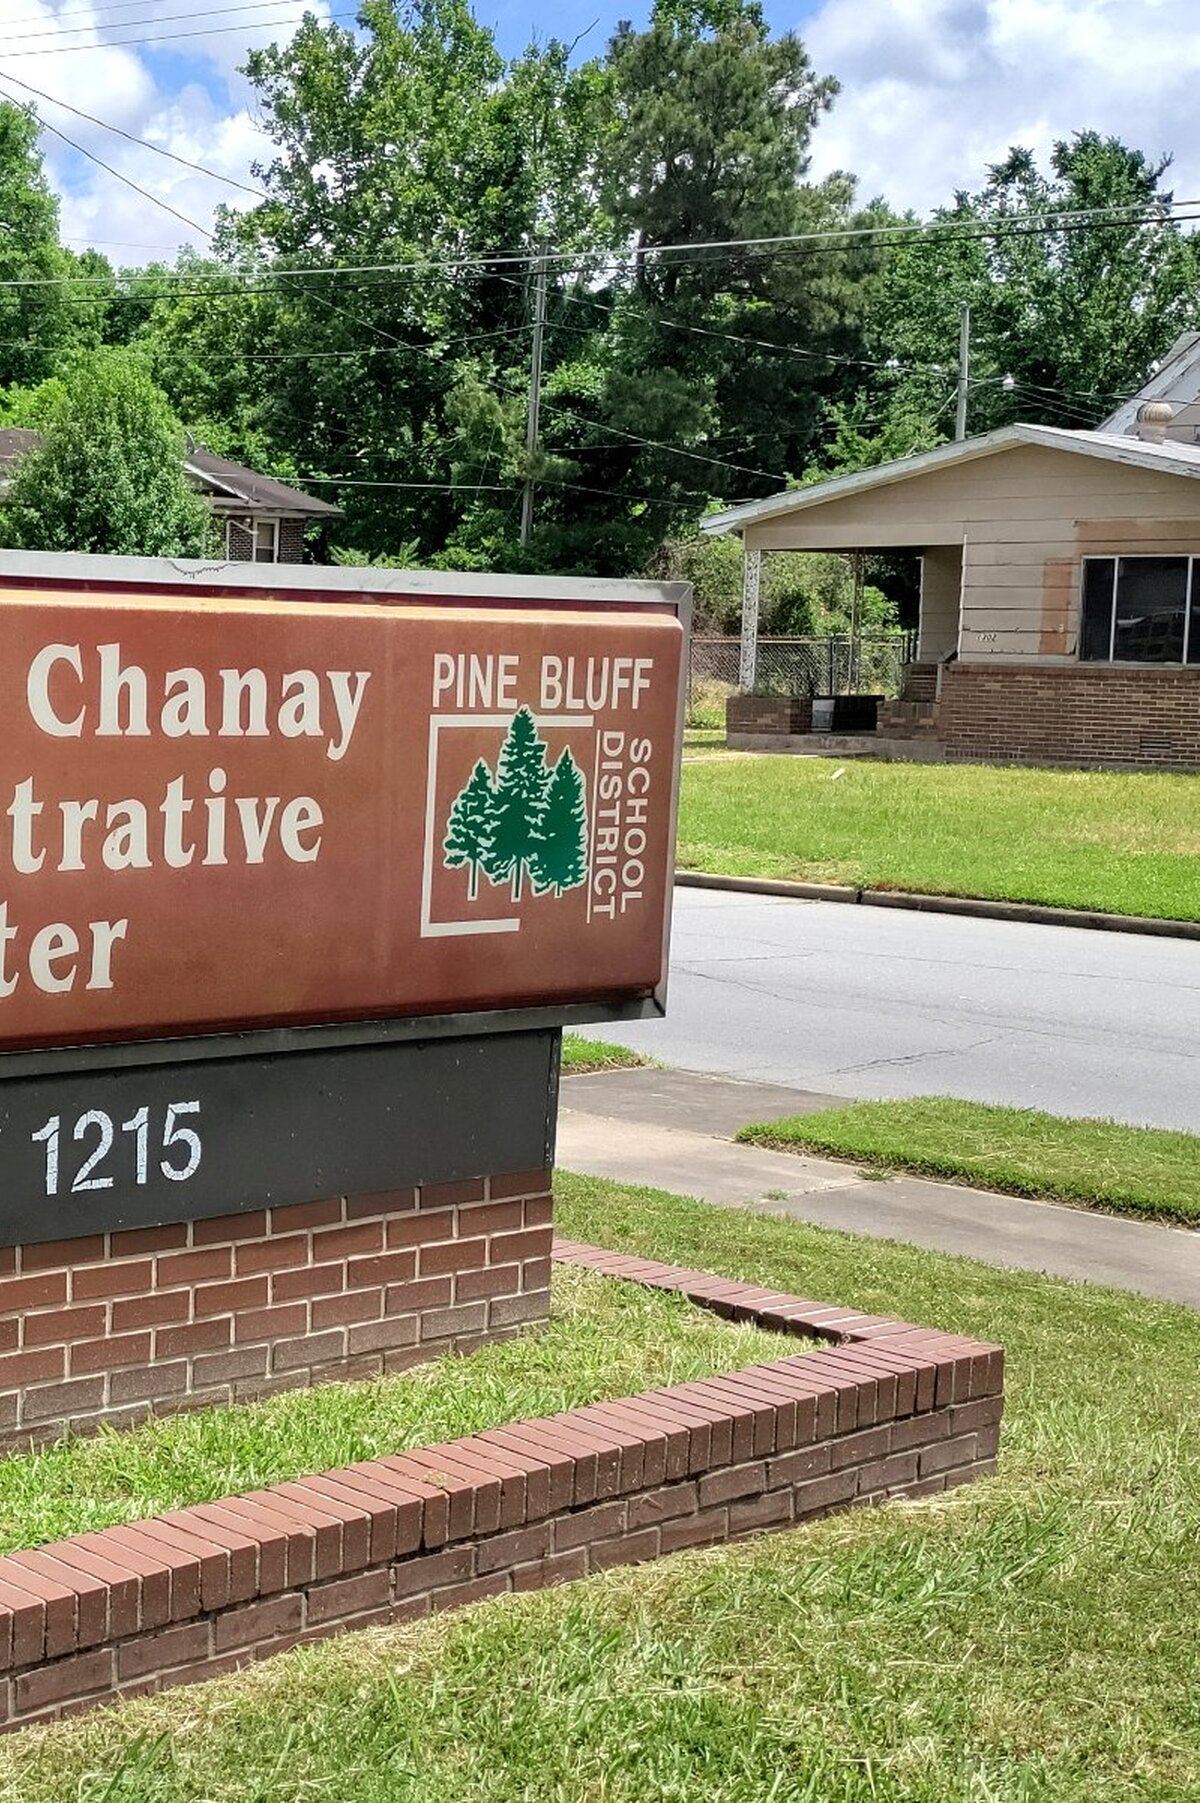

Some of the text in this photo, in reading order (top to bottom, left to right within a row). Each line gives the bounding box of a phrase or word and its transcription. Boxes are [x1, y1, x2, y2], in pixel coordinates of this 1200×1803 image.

[26, 643, 372, 762] Chanay
[432, 653, 654, 711] PINE BLUFF
[593, 731, 625, 920] DISTRICT
[620, 737, 652, 914] SCHOOL
[31, 1101, 202, 1196] 1215
